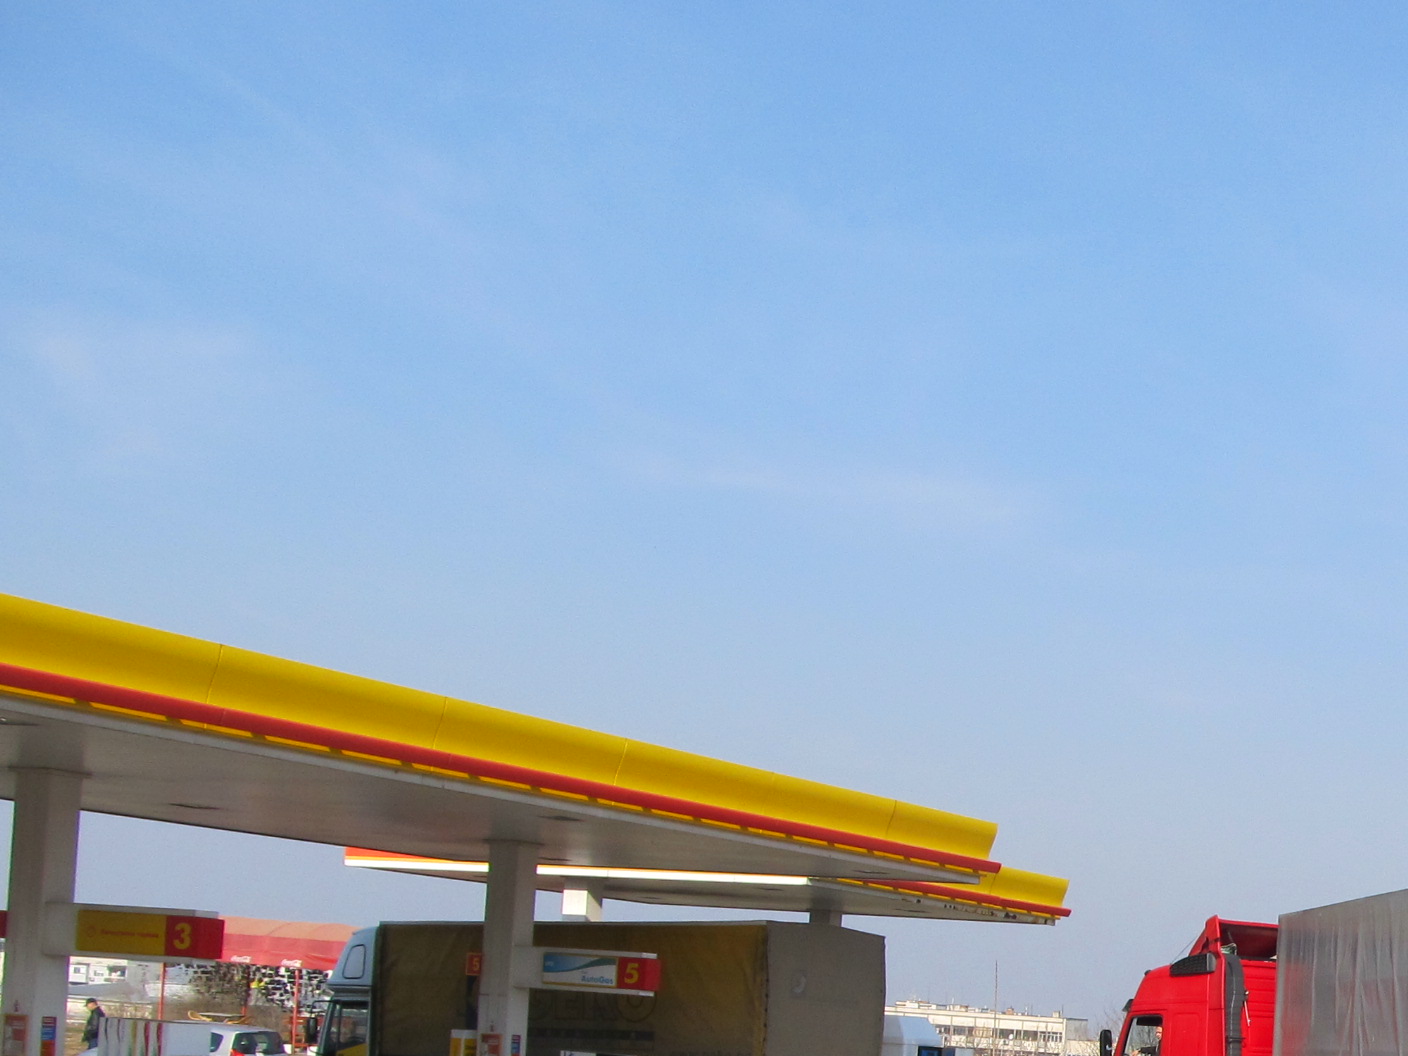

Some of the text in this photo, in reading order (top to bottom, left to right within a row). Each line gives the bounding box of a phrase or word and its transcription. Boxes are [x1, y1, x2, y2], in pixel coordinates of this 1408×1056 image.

[173, 922, 192, 950] 3
[472, 957, 480, 971] 5
[624, 962, 640, 984] 5
